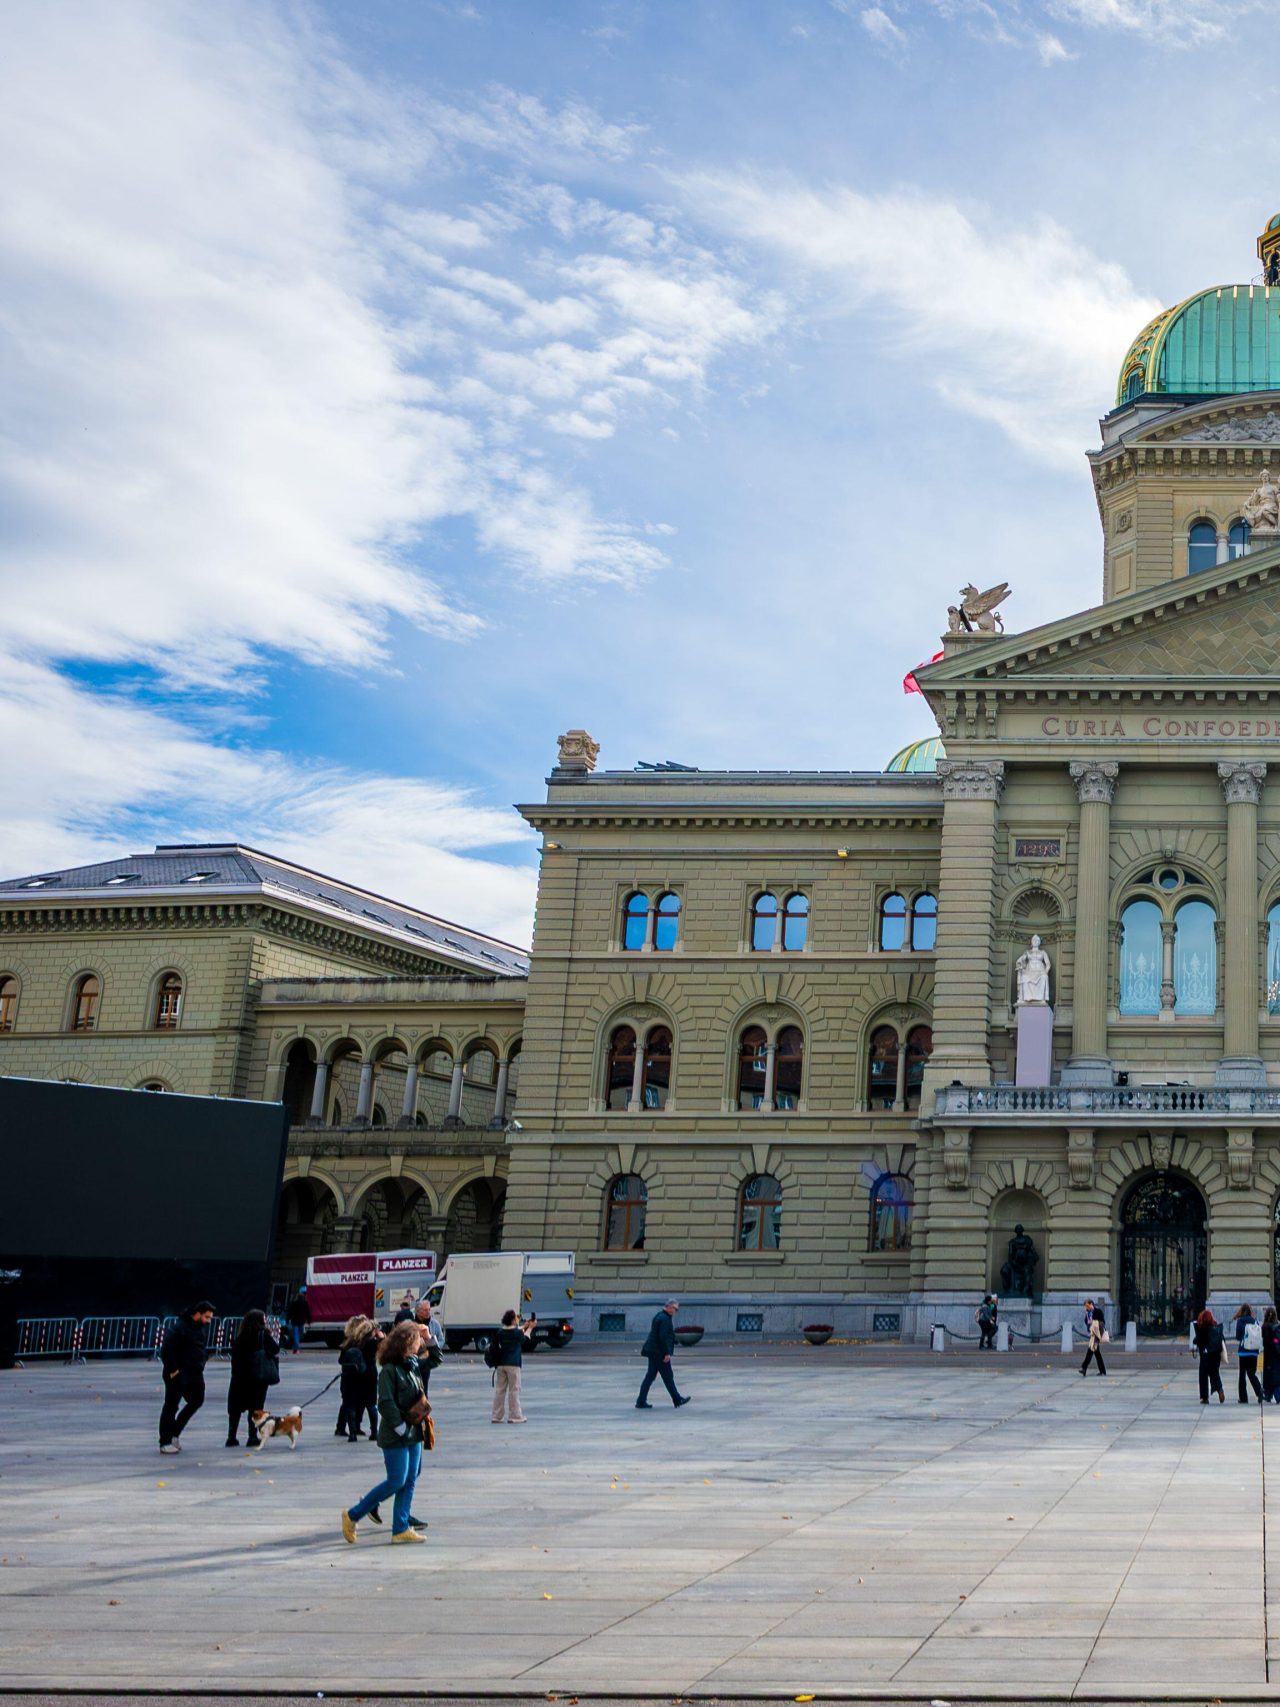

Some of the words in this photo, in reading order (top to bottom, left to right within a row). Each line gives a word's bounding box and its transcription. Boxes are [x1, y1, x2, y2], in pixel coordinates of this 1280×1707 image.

[1041, 717, 1126, 737] CURIA
[382, 1258, 428, 1270] PLANZER
[340, 1273, 369, 1283] PLANZER
